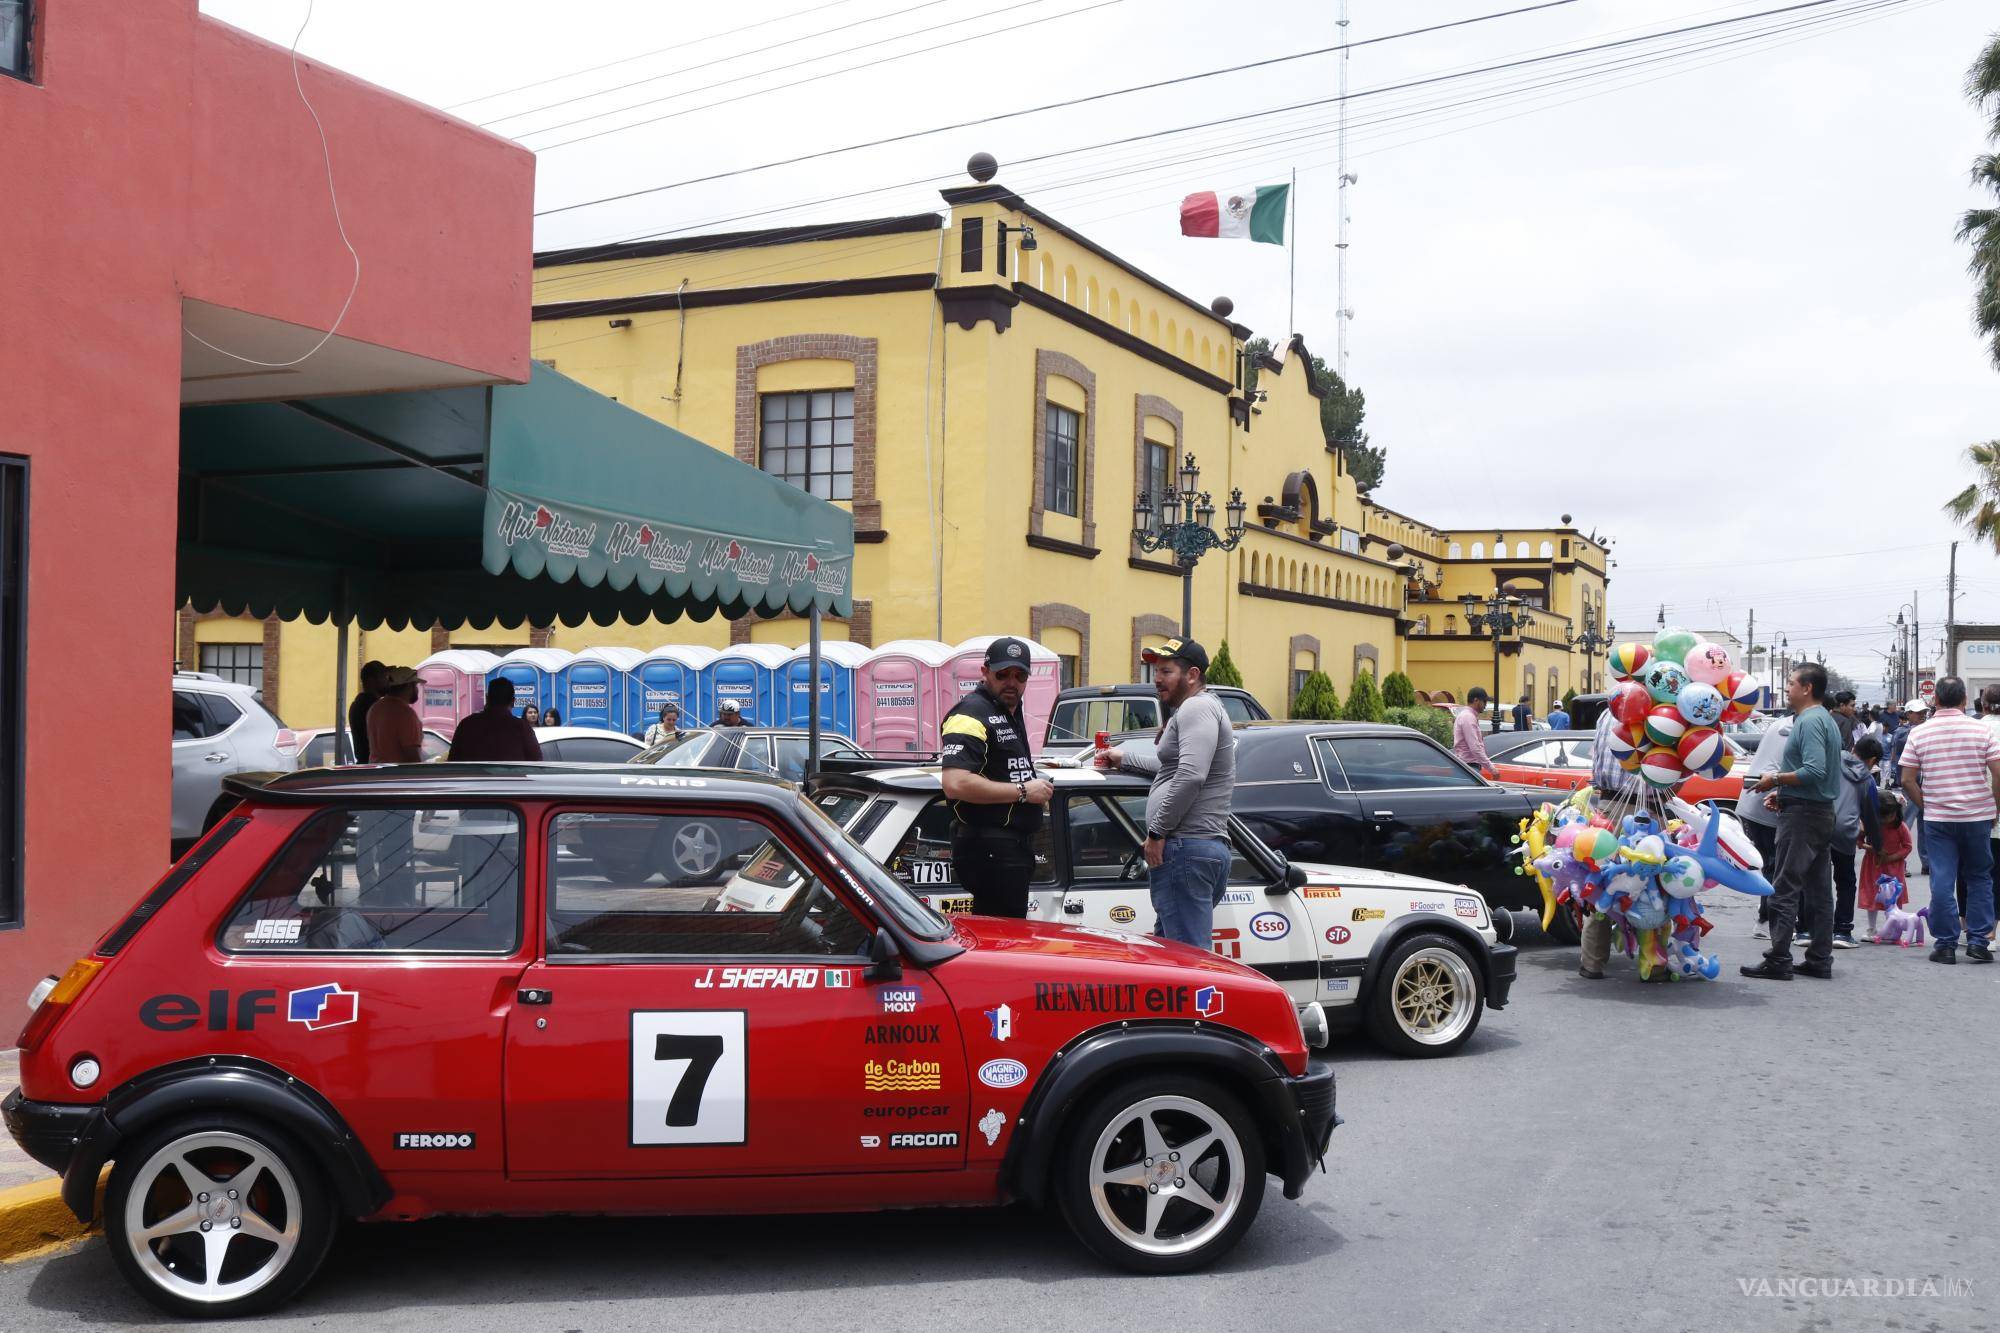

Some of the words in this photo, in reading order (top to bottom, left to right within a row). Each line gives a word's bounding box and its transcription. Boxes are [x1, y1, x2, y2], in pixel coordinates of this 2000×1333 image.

[541, 513, 597, 548] Natural
[643, 531, 692, 563] Natural
[732, 546, 774, 576] Natural
[810, 560, 847, 588] Natural
[620, 776, 707, 787] PARIS
[914, 863, 951, 883] 7791
[838, 867, 875, 907] FACOM
[1303, 886, 1341, 899] PIRELLI
[1410, 901, 1446, 910] BFGoodrich
[1329, 928, 1348, 941] STP
[695, 969, 713, 988] J.
[719, 969, 818, 988] SHEPARD
[883, 991, 916, 1002] LIQUI
[1034, 982, 1138, 1013] RENAULT
[1144, 985, 1189, 1013] elf
[139, 989, 276, 1032] elf
[884, 1002, 916, 1013] MOLY
[1001, 1019, 1008, 1028] F
[864, 1025, 940, 1045] ARNOUX
[864, 1059, 883, 1076] de
[887, 1059, 940, 1076] Carbon
[654, 1033, 724, 1127] 7
[863, 1105, 950, 1119] europcar
[400, 1134, 471, 1147] FERODO
[891, 1133, 957, 1147] FACOM
